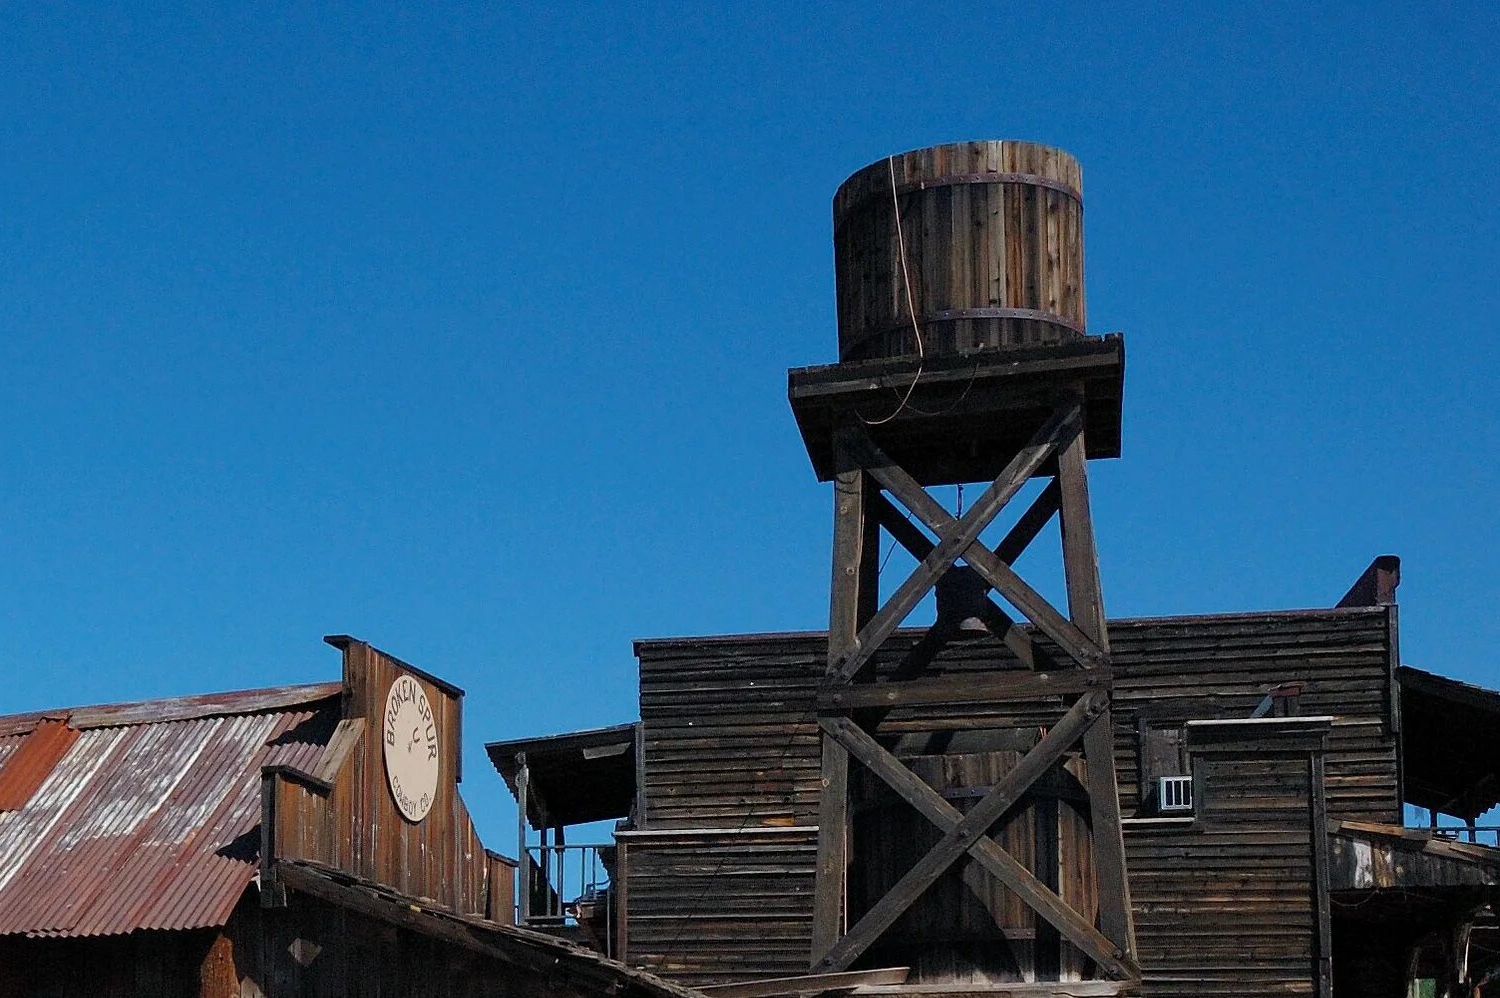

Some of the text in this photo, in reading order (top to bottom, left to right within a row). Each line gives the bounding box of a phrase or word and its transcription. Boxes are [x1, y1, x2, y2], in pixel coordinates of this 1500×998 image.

[386, 680, 437, 761] BROKEN SPUR
[393, 775, 417, 816] COWBOY
